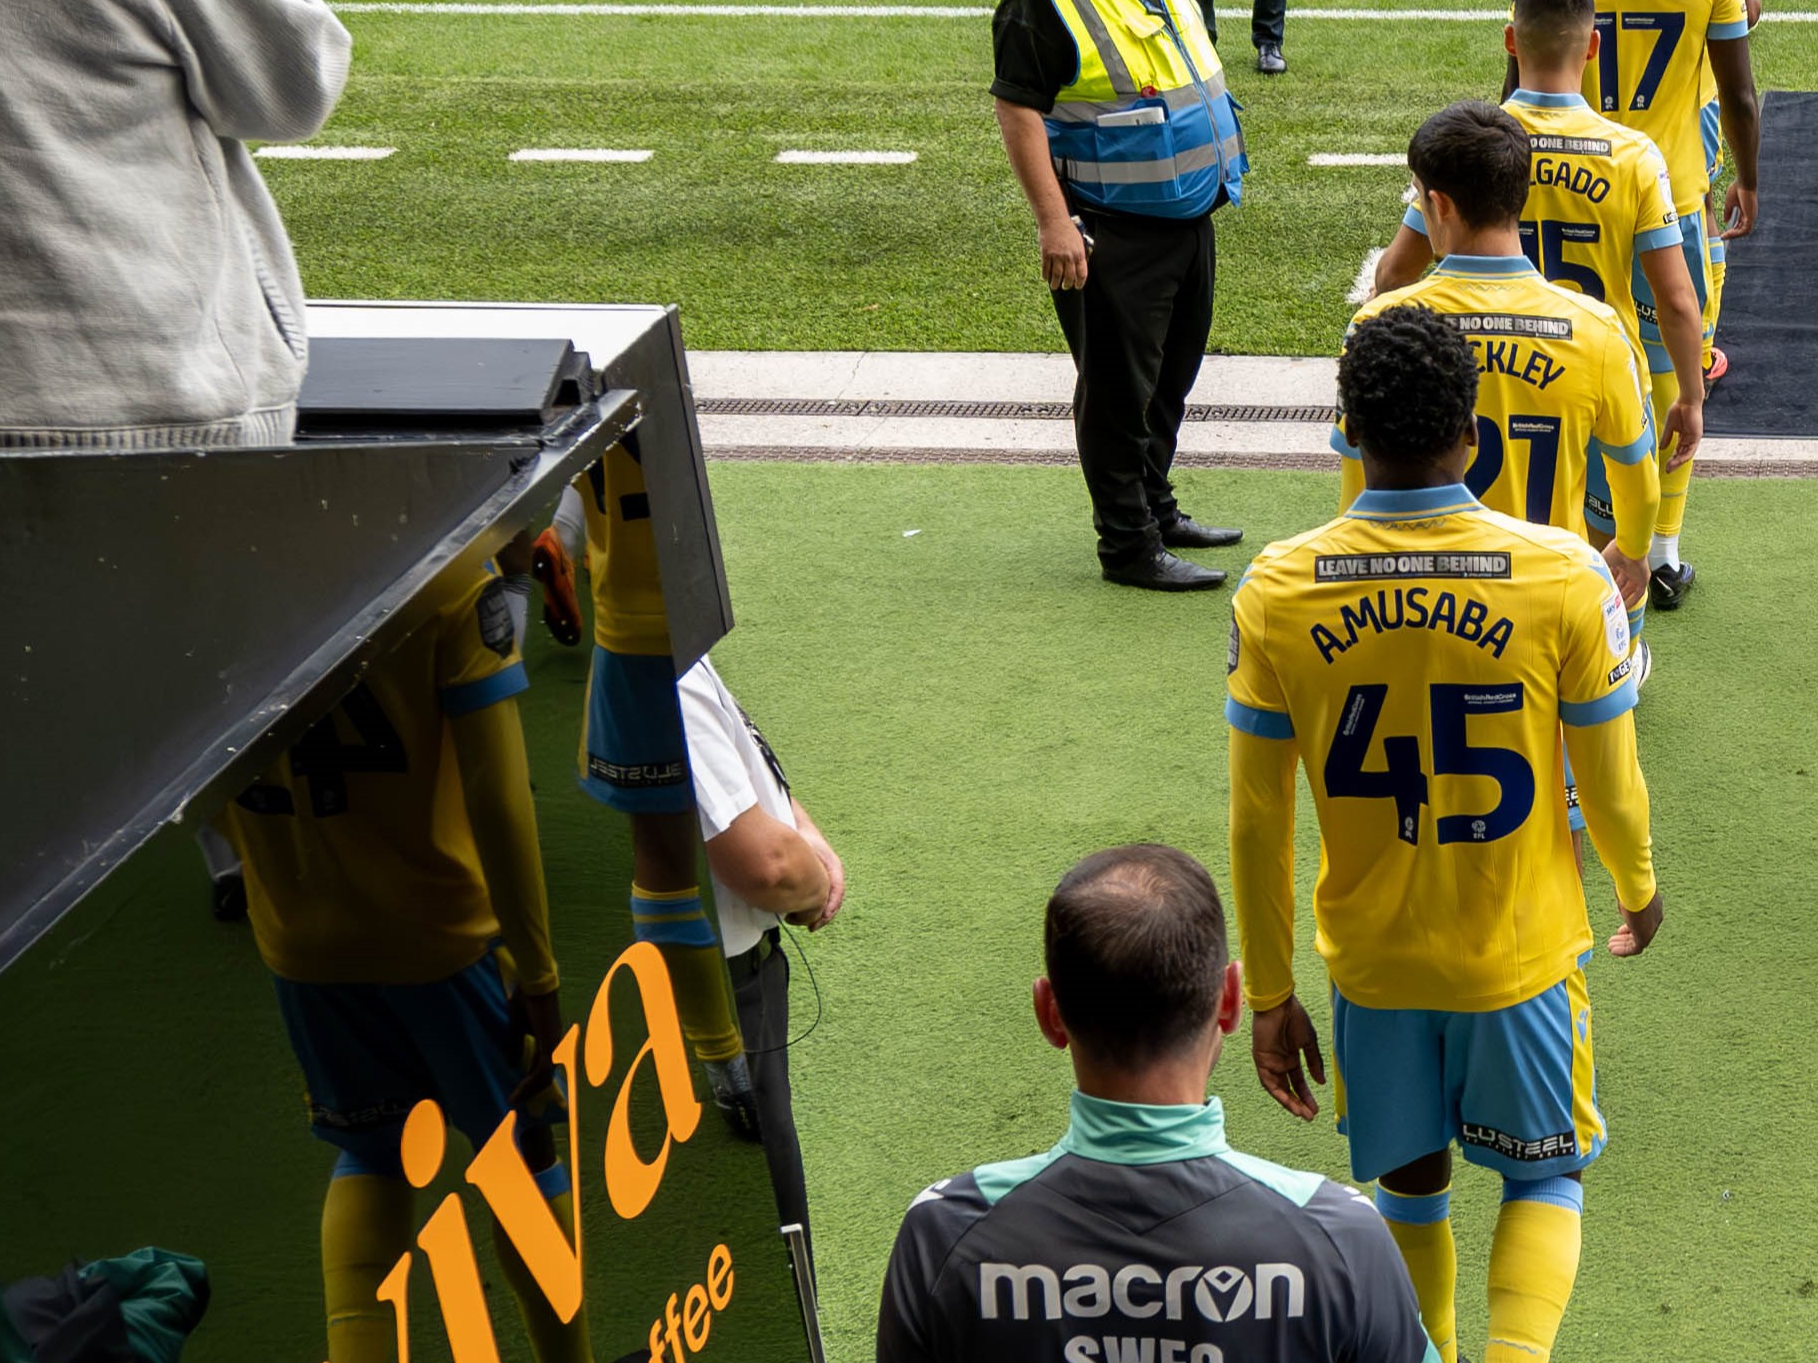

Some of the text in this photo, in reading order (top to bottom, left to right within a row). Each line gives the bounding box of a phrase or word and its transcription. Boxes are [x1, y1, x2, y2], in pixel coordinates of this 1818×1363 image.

[1594, 11, 1686, 113] 17
[1538, 136, 1610, 152] ONE BEHIND
[1459, 316, 1570, 335] NO ONE BEHIND
[1318, 554, 1508, 576] LEAVE NO ONE BEHIND
[1310, 586, 1515, 665] A.MUSABA
[1323, 682, 1536, 846] 45
[980, 1262, 1306, 1323] macron
